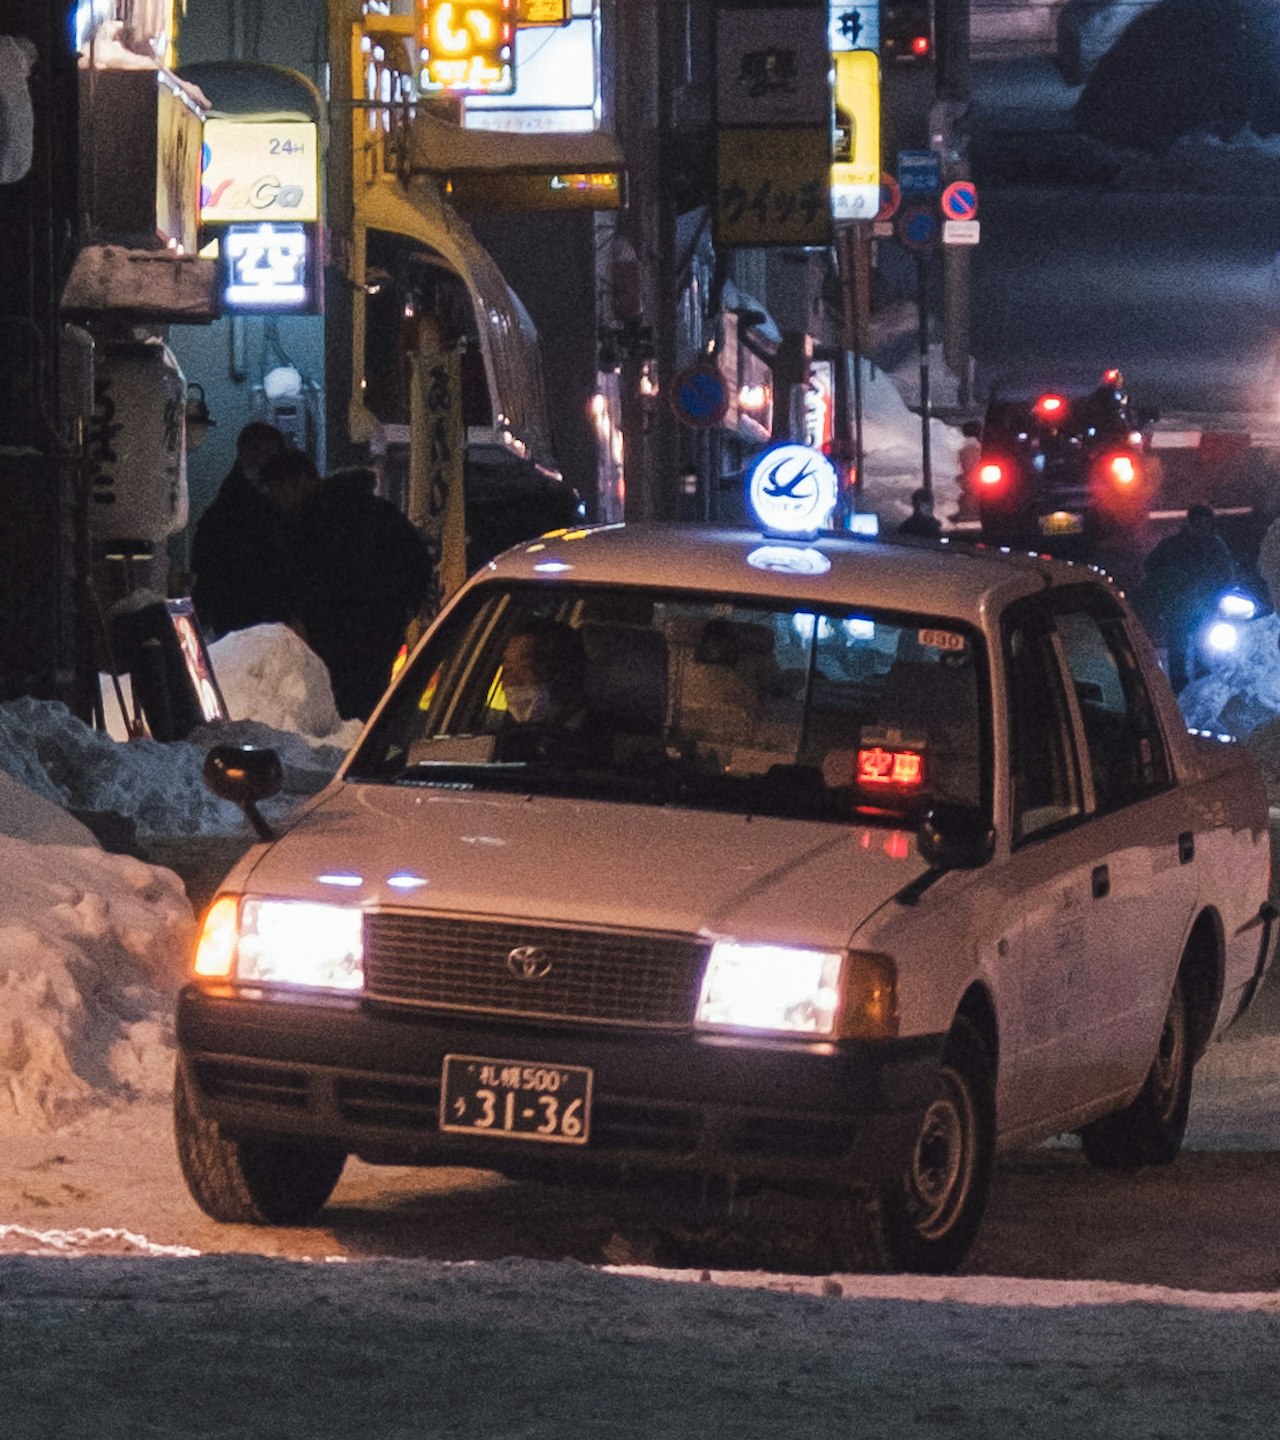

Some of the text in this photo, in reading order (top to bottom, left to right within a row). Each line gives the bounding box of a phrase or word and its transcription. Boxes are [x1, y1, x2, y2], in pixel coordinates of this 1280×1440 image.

[227, 223, 305, 303] 空
[858, 748, 923, 784] 空車
[474, 1088, 584, 1137] 31-36
